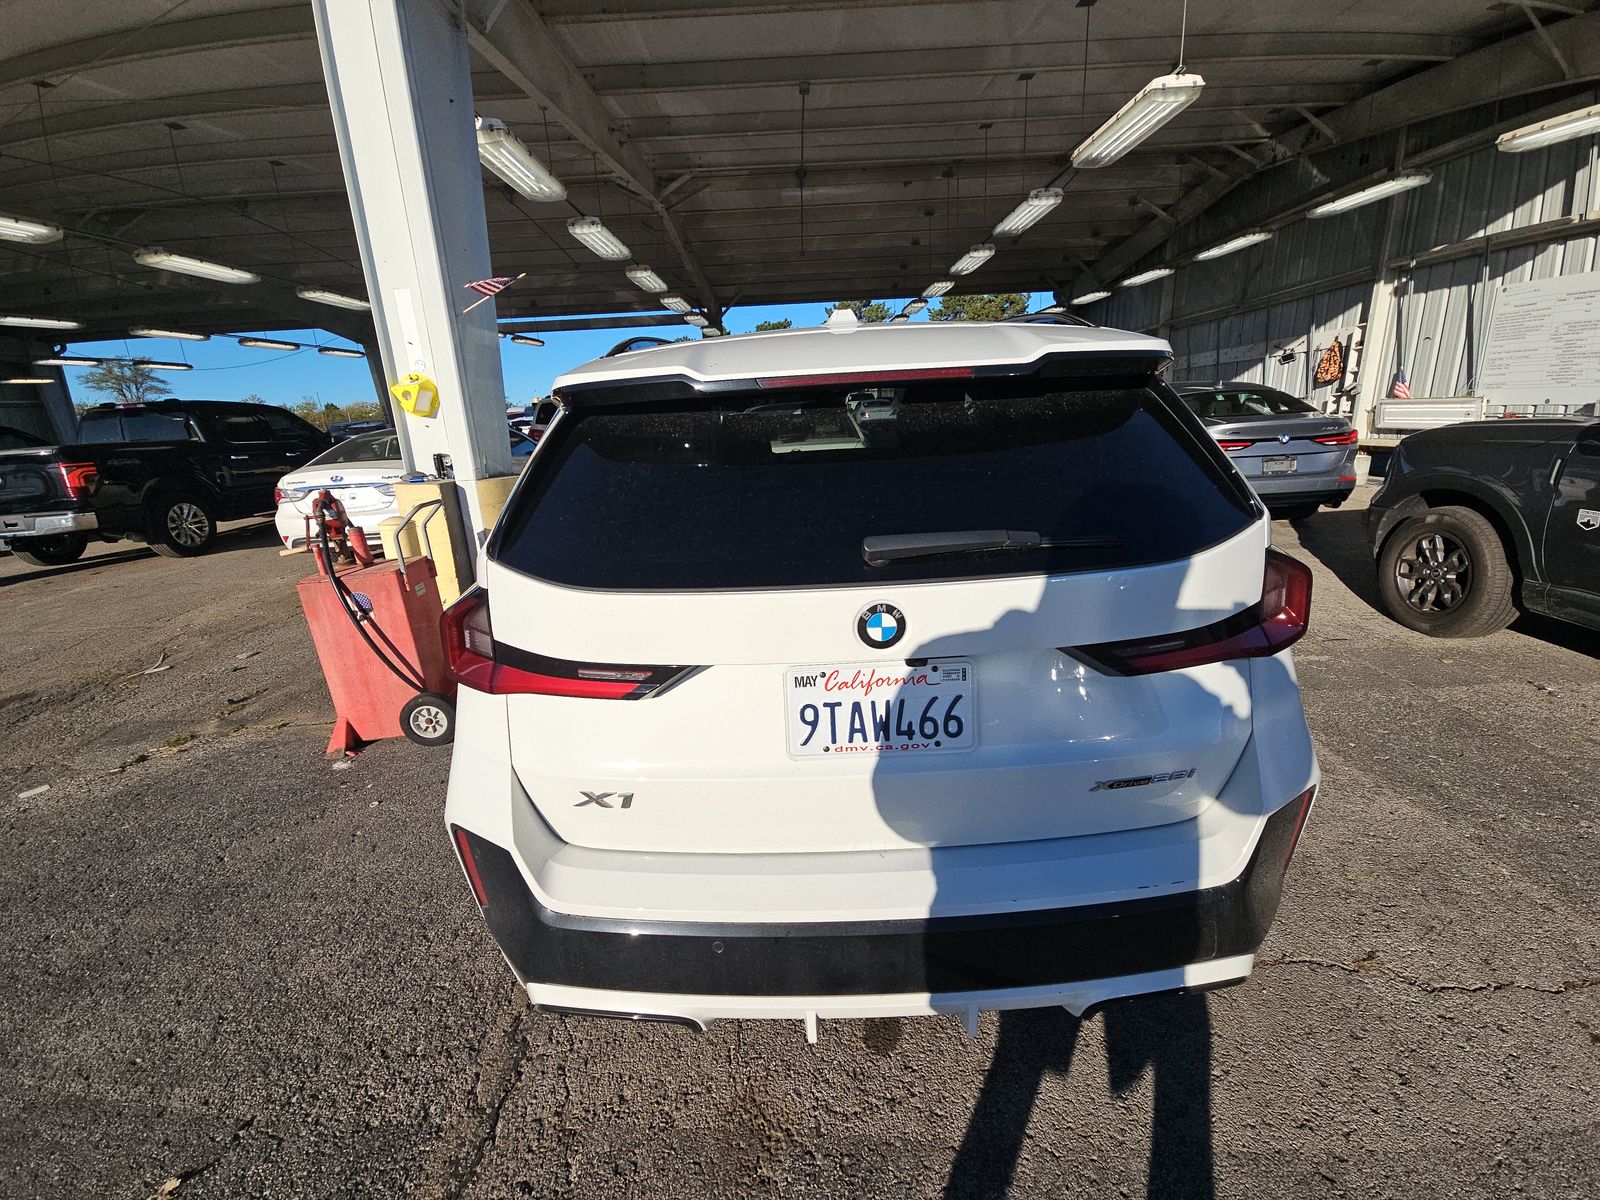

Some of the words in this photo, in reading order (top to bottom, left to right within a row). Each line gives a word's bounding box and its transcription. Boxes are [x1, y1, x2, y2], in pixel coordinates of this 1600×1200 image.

[794, 675, 818, 688] MAY
[824, 668, 941, 697] California
[799, 694, 964, 747] 9TAW466
[834, 742, 931, 753] dmv.ca.gov
[573, 790, 635, 809] X1
